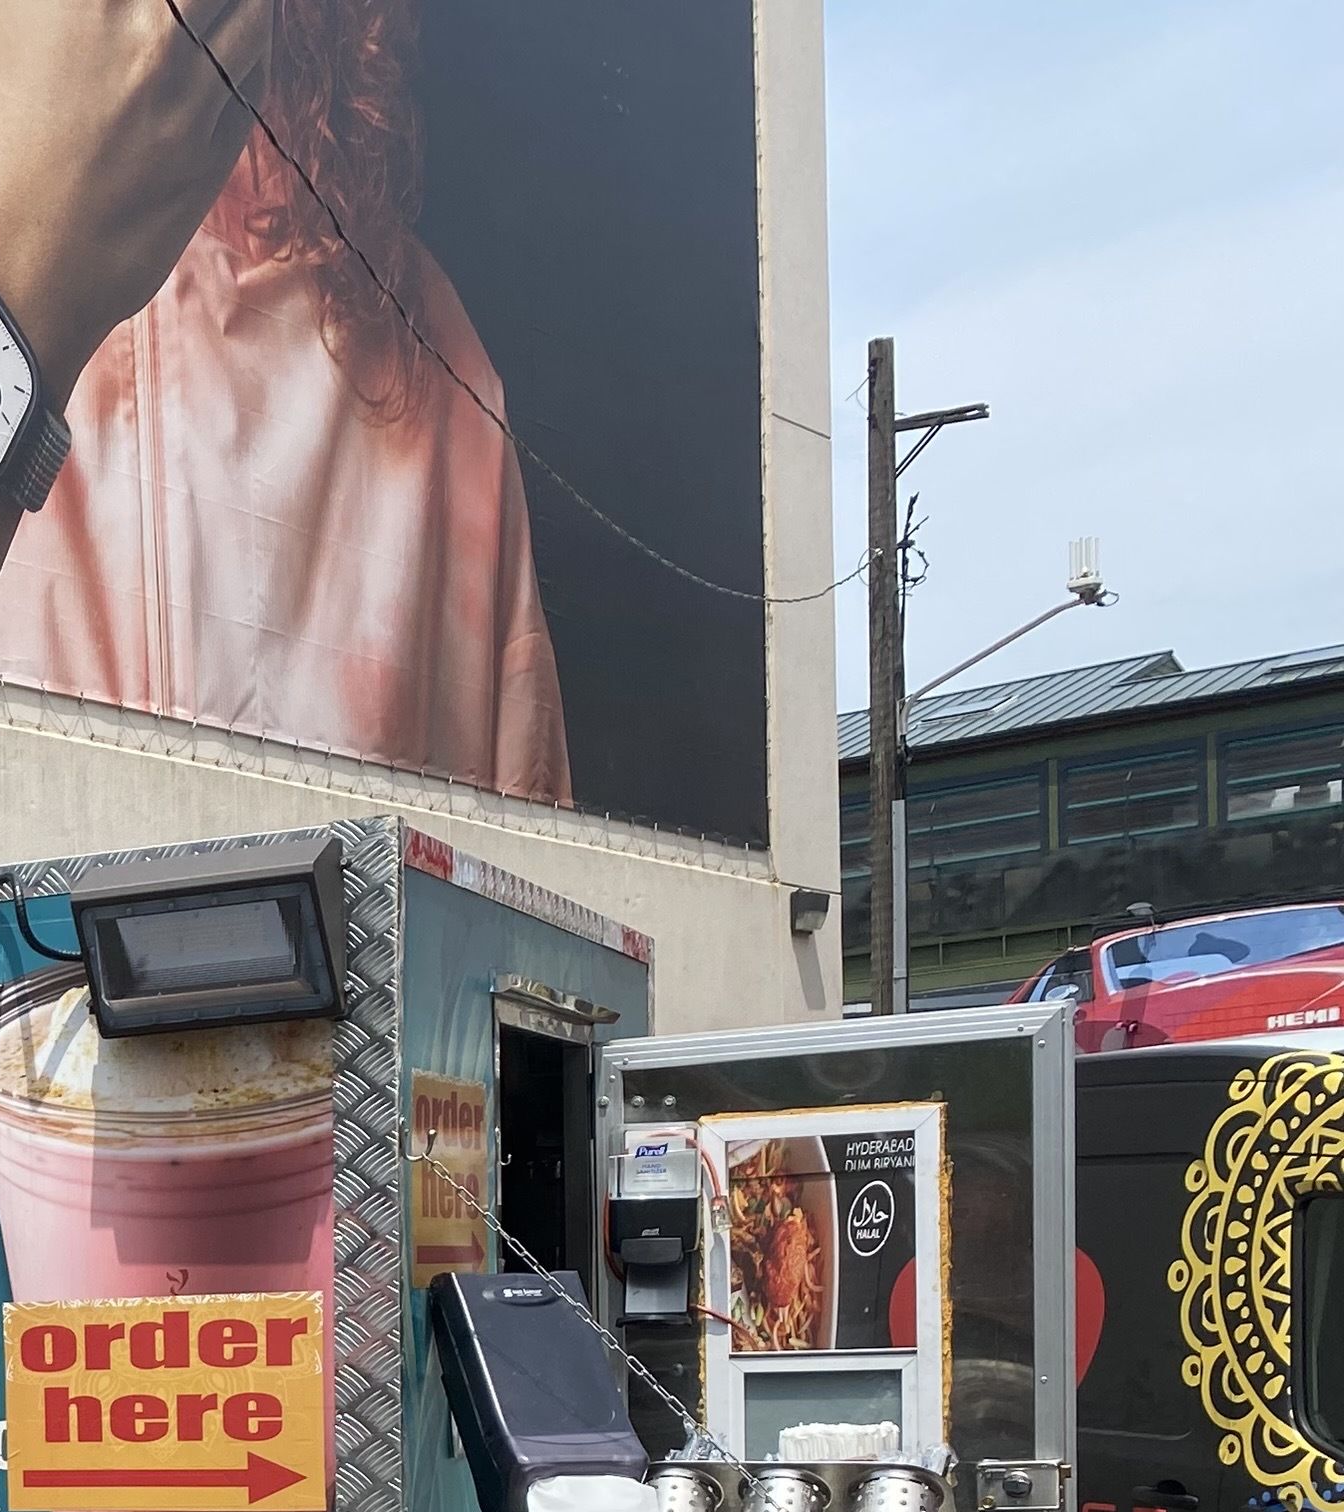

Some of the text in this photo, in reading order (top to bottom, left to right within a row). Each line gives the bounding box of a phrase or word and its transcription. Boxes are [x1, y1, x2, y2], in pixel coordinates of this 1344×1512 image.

[1267, 1006, 1341, 1030] HEMI
[415, 1091, 484, 1151] order
[421, 1167, 480, 1221] here
[856, 1228, 880, 1240] HALAL
[20, 1310, 308, 1373] order
[43, 1386, 283, 1444] here
